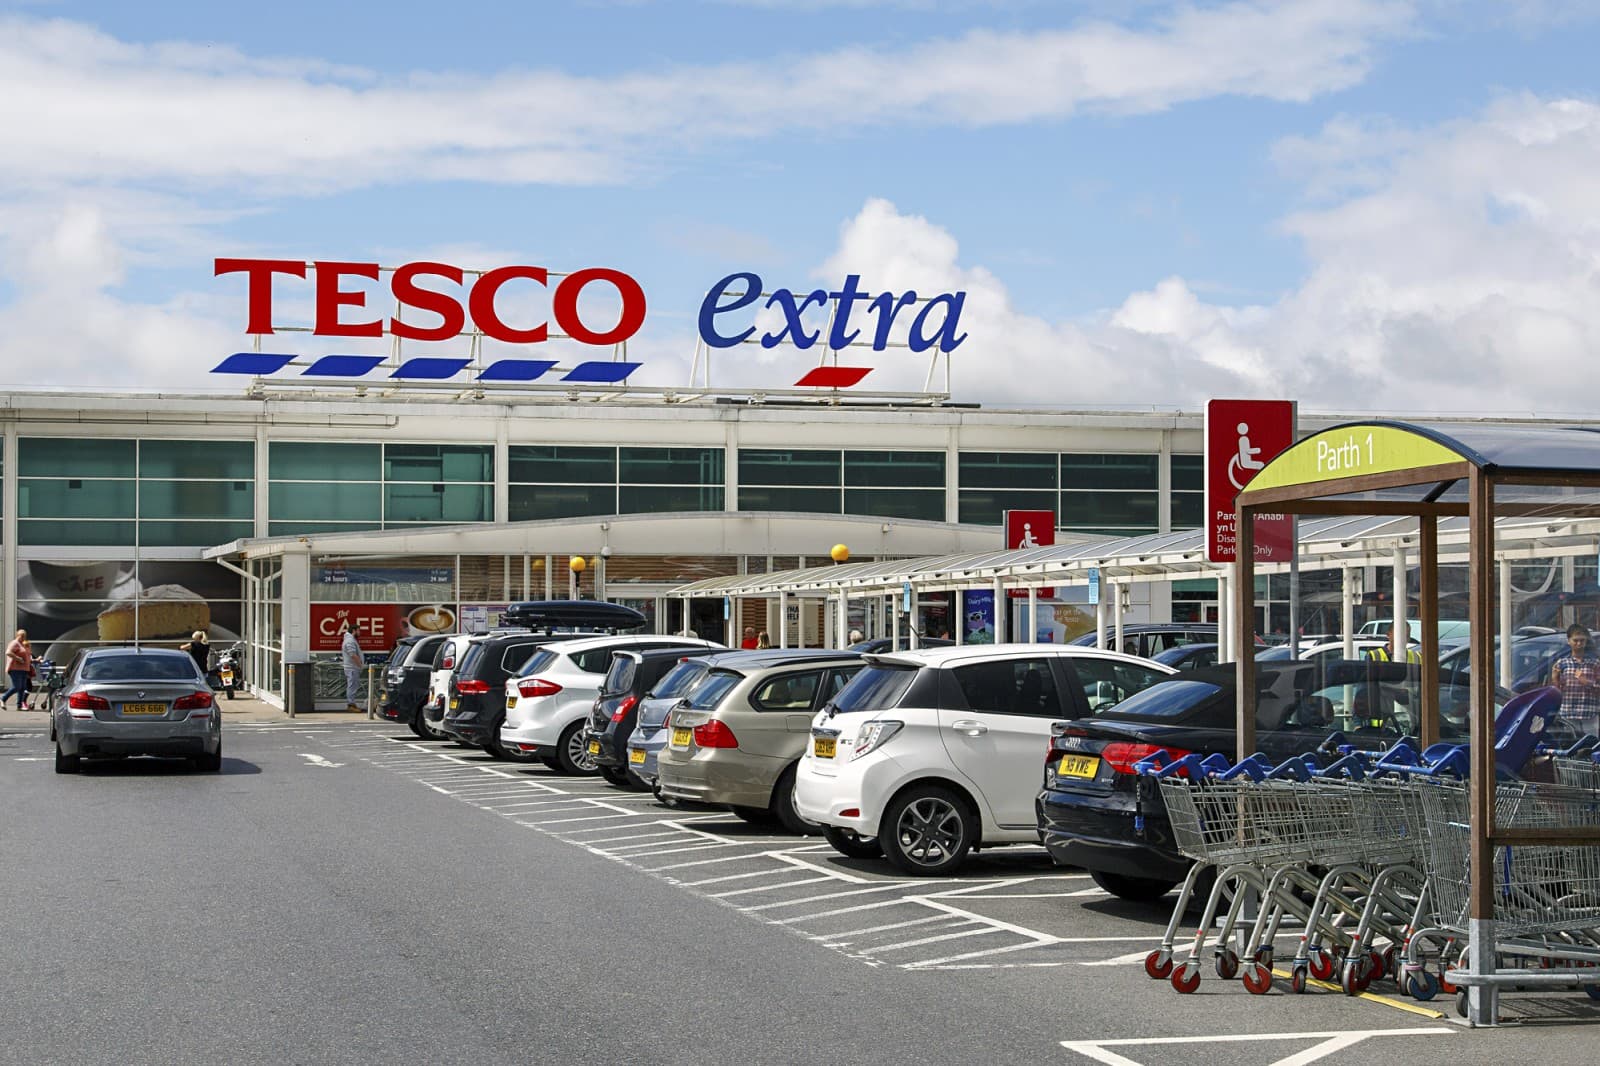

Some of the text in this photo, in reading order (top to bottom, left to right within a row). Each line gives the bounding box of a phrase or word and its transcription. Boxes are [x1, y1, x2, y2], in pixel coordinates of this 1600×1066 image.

[214, 258, 969, 353] TESCO extra
[1317, 432, 1374, 473] Parth 1
[1217, 511, 1237, 521] Parc
[1216, 525, 1229, 534] yn
[1217, 534, 1236, 543] Disa
[1217, 545, 1237, 555] Park
